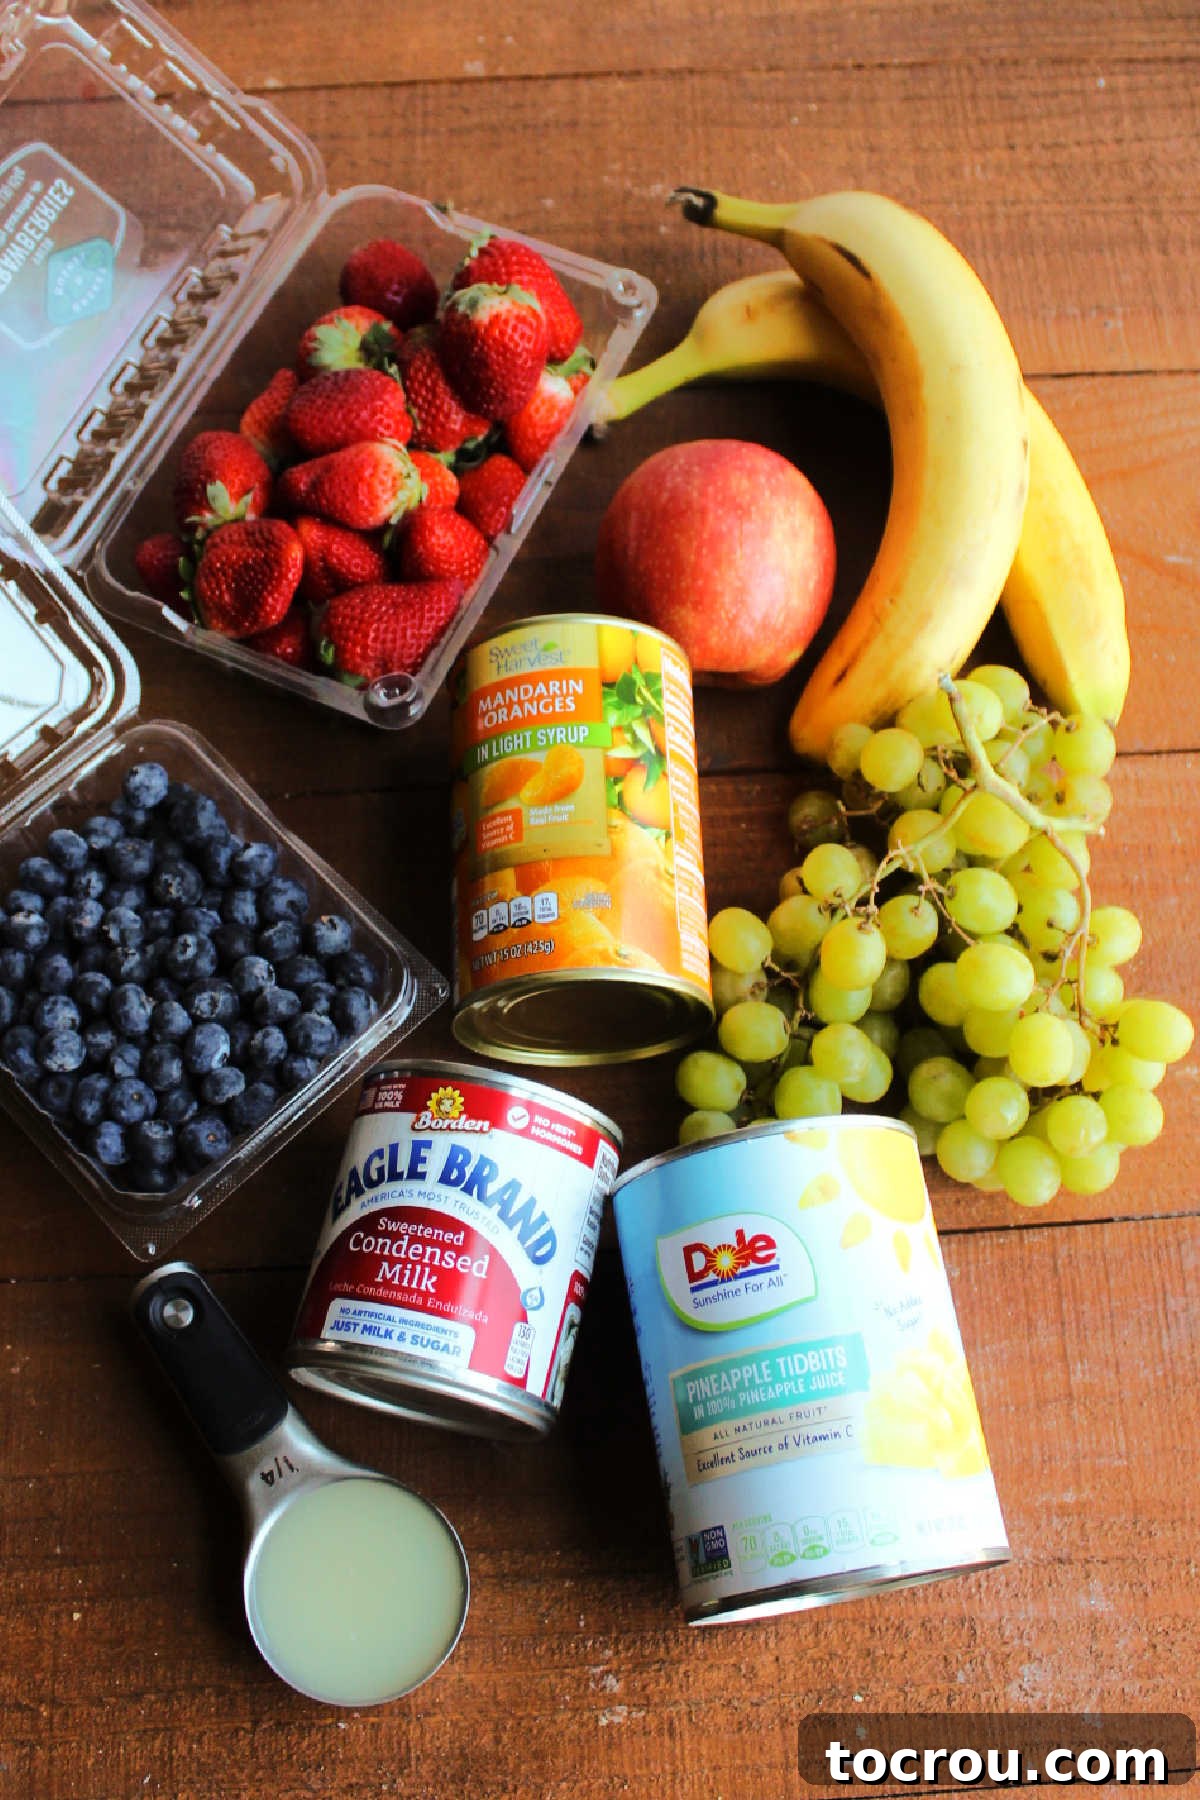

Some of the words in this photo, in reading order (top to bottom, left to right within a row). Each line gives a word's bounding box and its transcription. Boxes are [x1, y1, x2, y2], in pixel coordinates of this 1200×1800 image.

[496, 650, 564, 675] Harvest
[479, 679, 584, 713] MANDARIN
[482, 697, 576, 728] ORANGES
[477, 747, 489, 763] IN
[493, 731, 532, 756] LIGHT
[537, 725, 589, 746] SYRUP
[415, 1112, 491, 1132] Borden
[332, 1139, 433, 1222] EAGLE
[438, 1143, 558, 1266] BRAND
[360, 1189, 414, 1210] AMERICA'S
[417, 1190, 449, 1203] MOST
[453, 1200, 500, 1235] TRUSTED
[377, 1217, 465, 1246] Sweetened
[350, 1232, 490, 1279] Condensed
[682, 1225, 777, 1283] Dole
[375, 1261, 438, 1293] Milk
[692, 1285, 742, 1310] Sunshine
[744, 1280, 765, 1294] For
[355, 1283, 423, 1306] Condensada
[427, 1294, 489, 1324] Endulzada
[330, 1320, 360, 1334] JUST
[360, 1324, 394, 1341] MILK
[397, 1331, 407, 1343] &
[410, 1335, 462, 1357] SUGAR
[339, 1306, 351, 1316] NO
[351, 1308, 397, 1323] ARTIFICIAL
[399, 1317, 460, 1339] INGREDIENTS
[686, 1360, 771, 1403] PINEAPPLE
[775, 1346, 847, 1379] TIDBITS
[693, 1406, 704, 1420] IN
[707, 1395, 736, 1416] 100%
[738, 1380, 806, 1408] PINEAPPLE
[809, 1372, 847, 1391] JUICE
[713, 1430, 730, 1441] ALL
[734, 1416, 784, 1435] NATURAL
[697, 1451, 736, 1473] Excellent
[738, 1444, 774, 1461] Source
[778, 1434, 790, 1452] of
[794, 1428, 842, 1448] Vitamin
